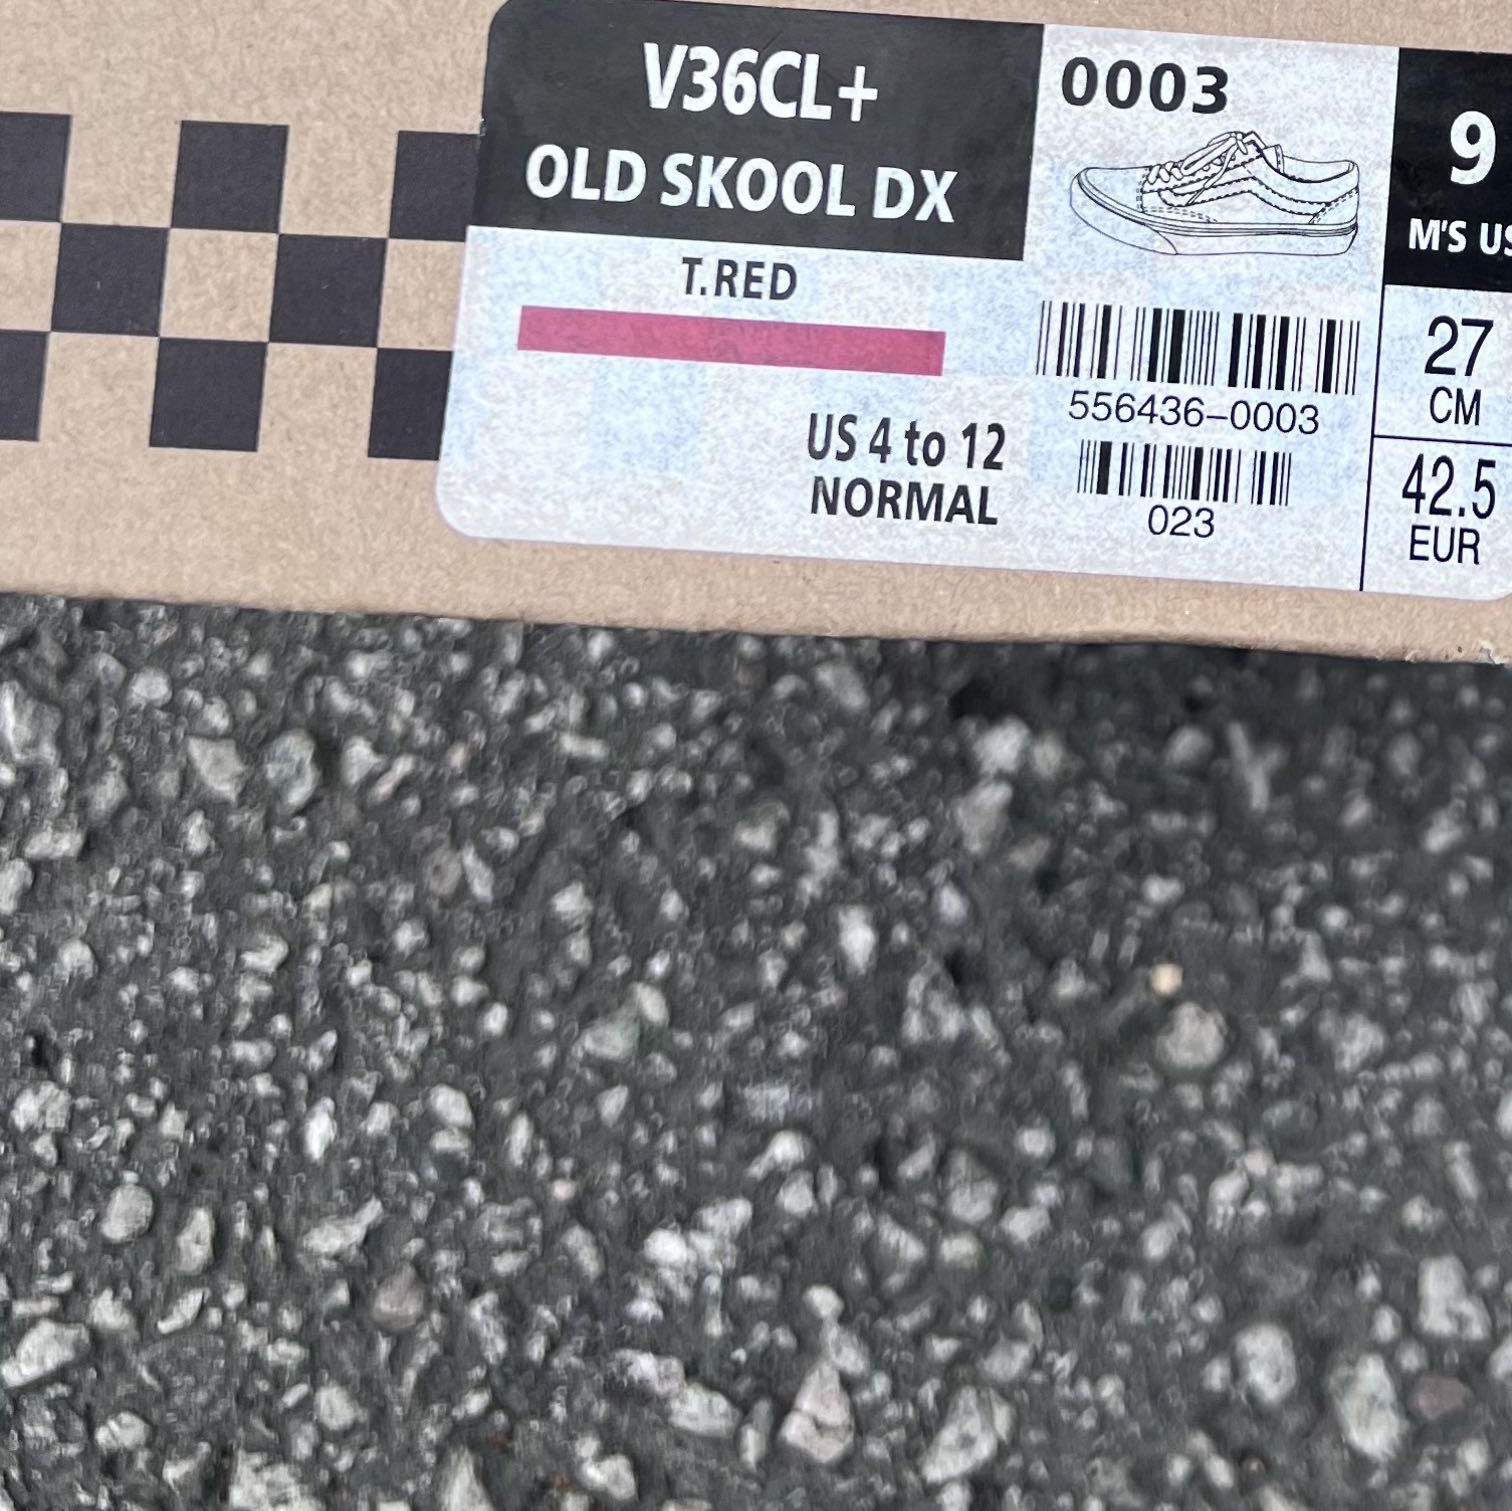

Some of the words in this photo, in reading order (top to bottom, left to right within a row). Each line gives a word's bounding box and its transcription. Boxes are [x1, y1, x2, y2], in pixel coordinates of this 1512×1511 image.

[643, 42, 878, 122] V36CL+
[1060, 56, 1229, 114] 0003
[1449, 110, 1498, 186] 9
[525, 143, 648, 202] OLD
[660, 153, 857, 217] SKOOL
[872, 166, 958, 224] DX
[1408, 218, 1467, 254] M'S
[681, 257, 799, 301] T.RED
[1424, 316, 1495, 378] 27
[1068, 390, 1319, 435] 556436-0003
[1430, 387, 1482, 426] CM
[807, 413, 858, 462] US
[869, 417, 892, 464] 4
[904, 421, 946, 466] to
[962, 423, 1006, 470] 12
[810, 476, 999, 526] NORMAL
[1402, 453, 1497, 520] 42.5
[1148, 506, 1215, 539] 023
[1409, 525, 1482, 565] EUR
